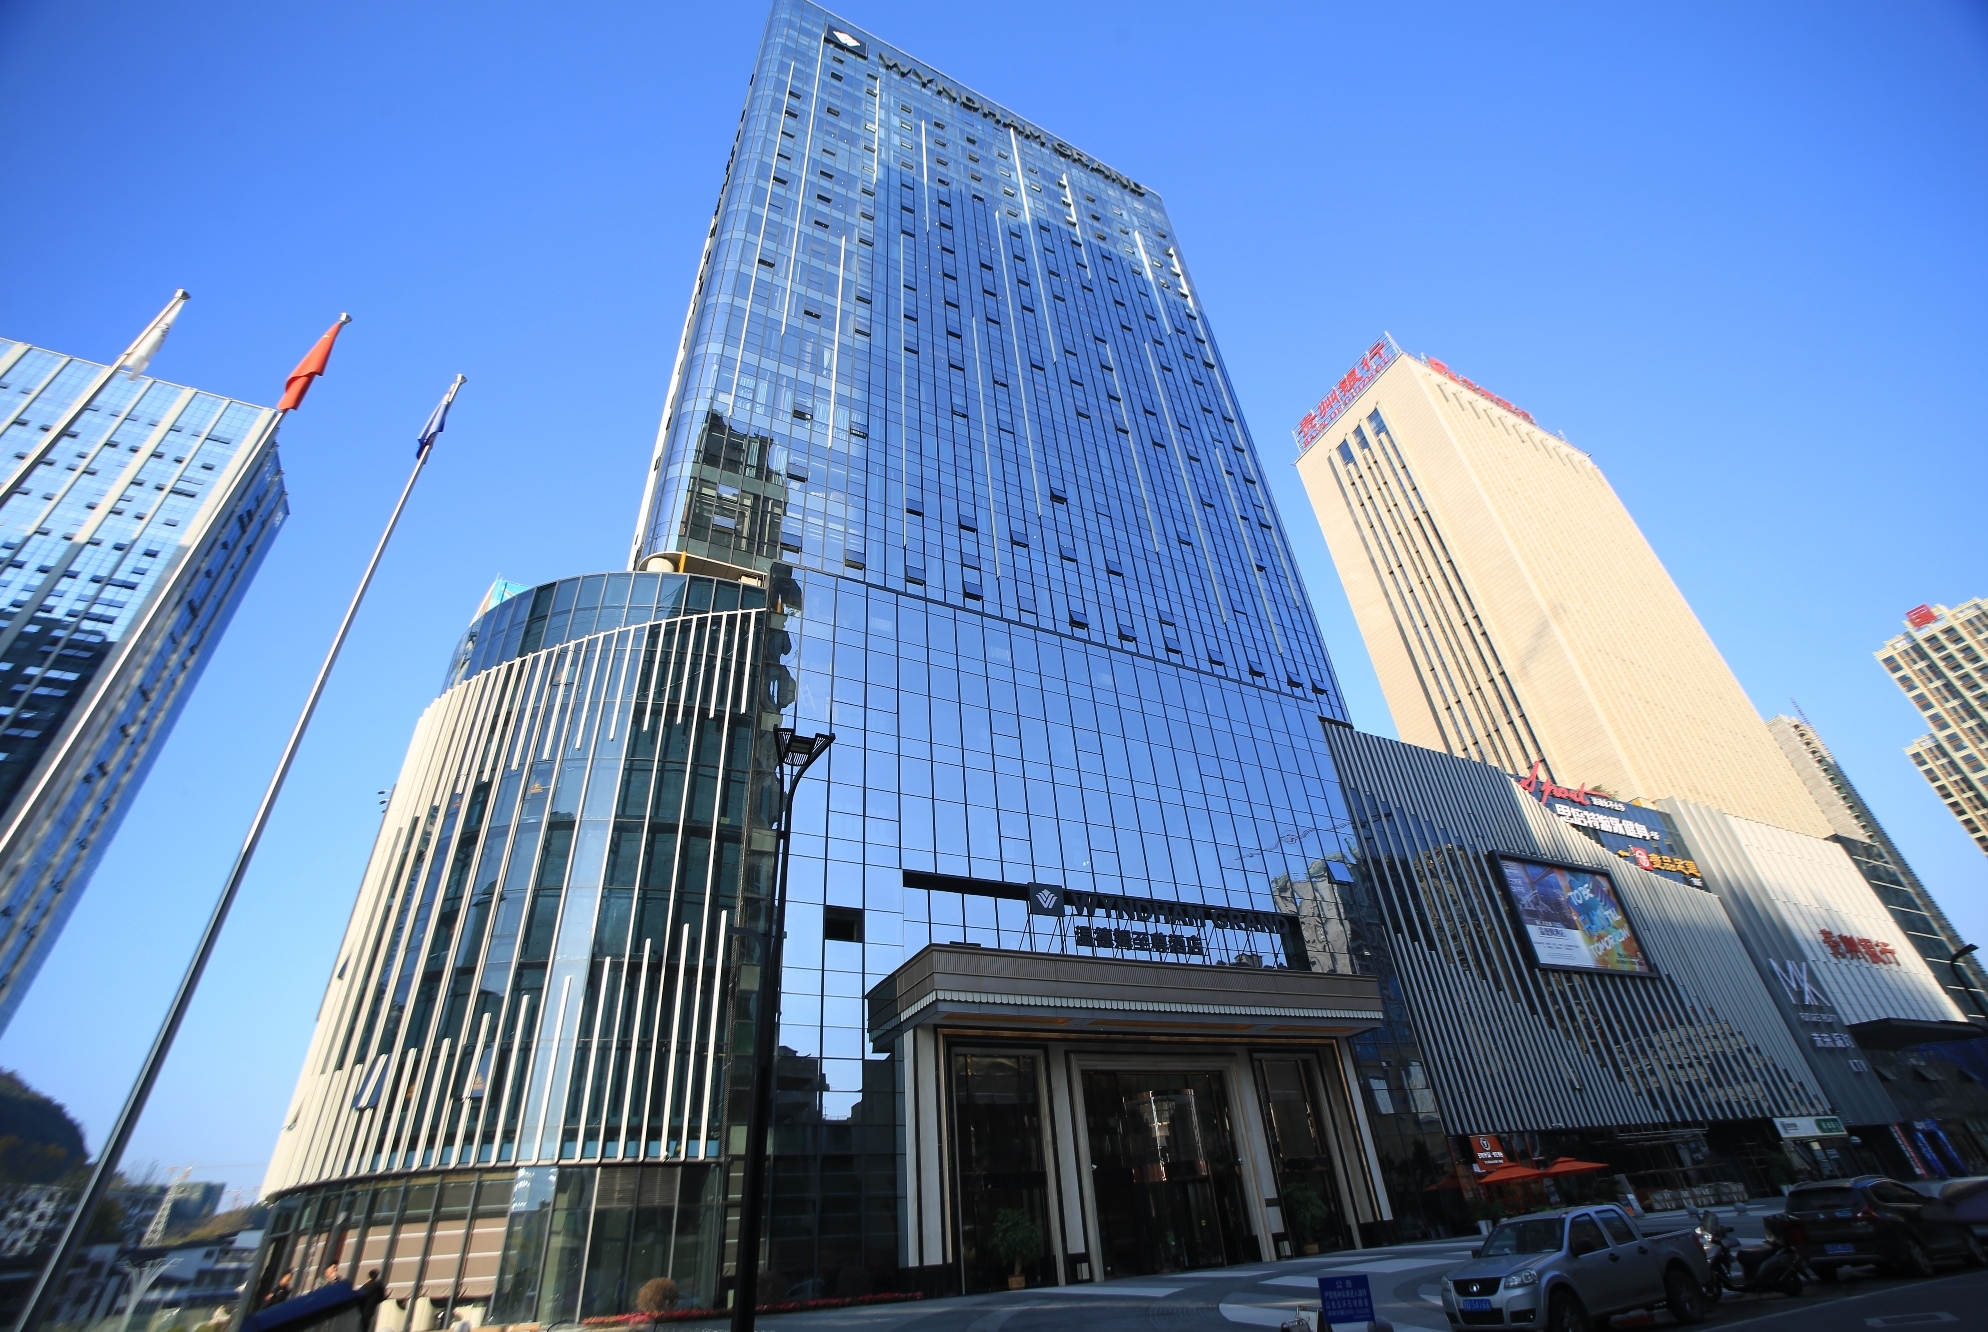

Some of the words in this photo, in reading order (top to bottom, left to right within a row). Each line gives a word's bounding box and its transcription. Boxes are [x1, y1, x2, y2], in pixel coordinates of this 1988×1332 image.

[879, 52, 1046, 147] WYNDHAM
[1052, 138, 1146, 196] GRAND
[1298, 342, 1385, 438] 贵州银行
[1517, 760, 1611, 806] Sport
[1072, 893, 1206, 927] WYNDHAM
[1211, 909, 1290, 934] GRAND
[1075, 925, 1203, 955] 温德姆至尊酒店
[1336, 1279, 1352, 1288] 公告
